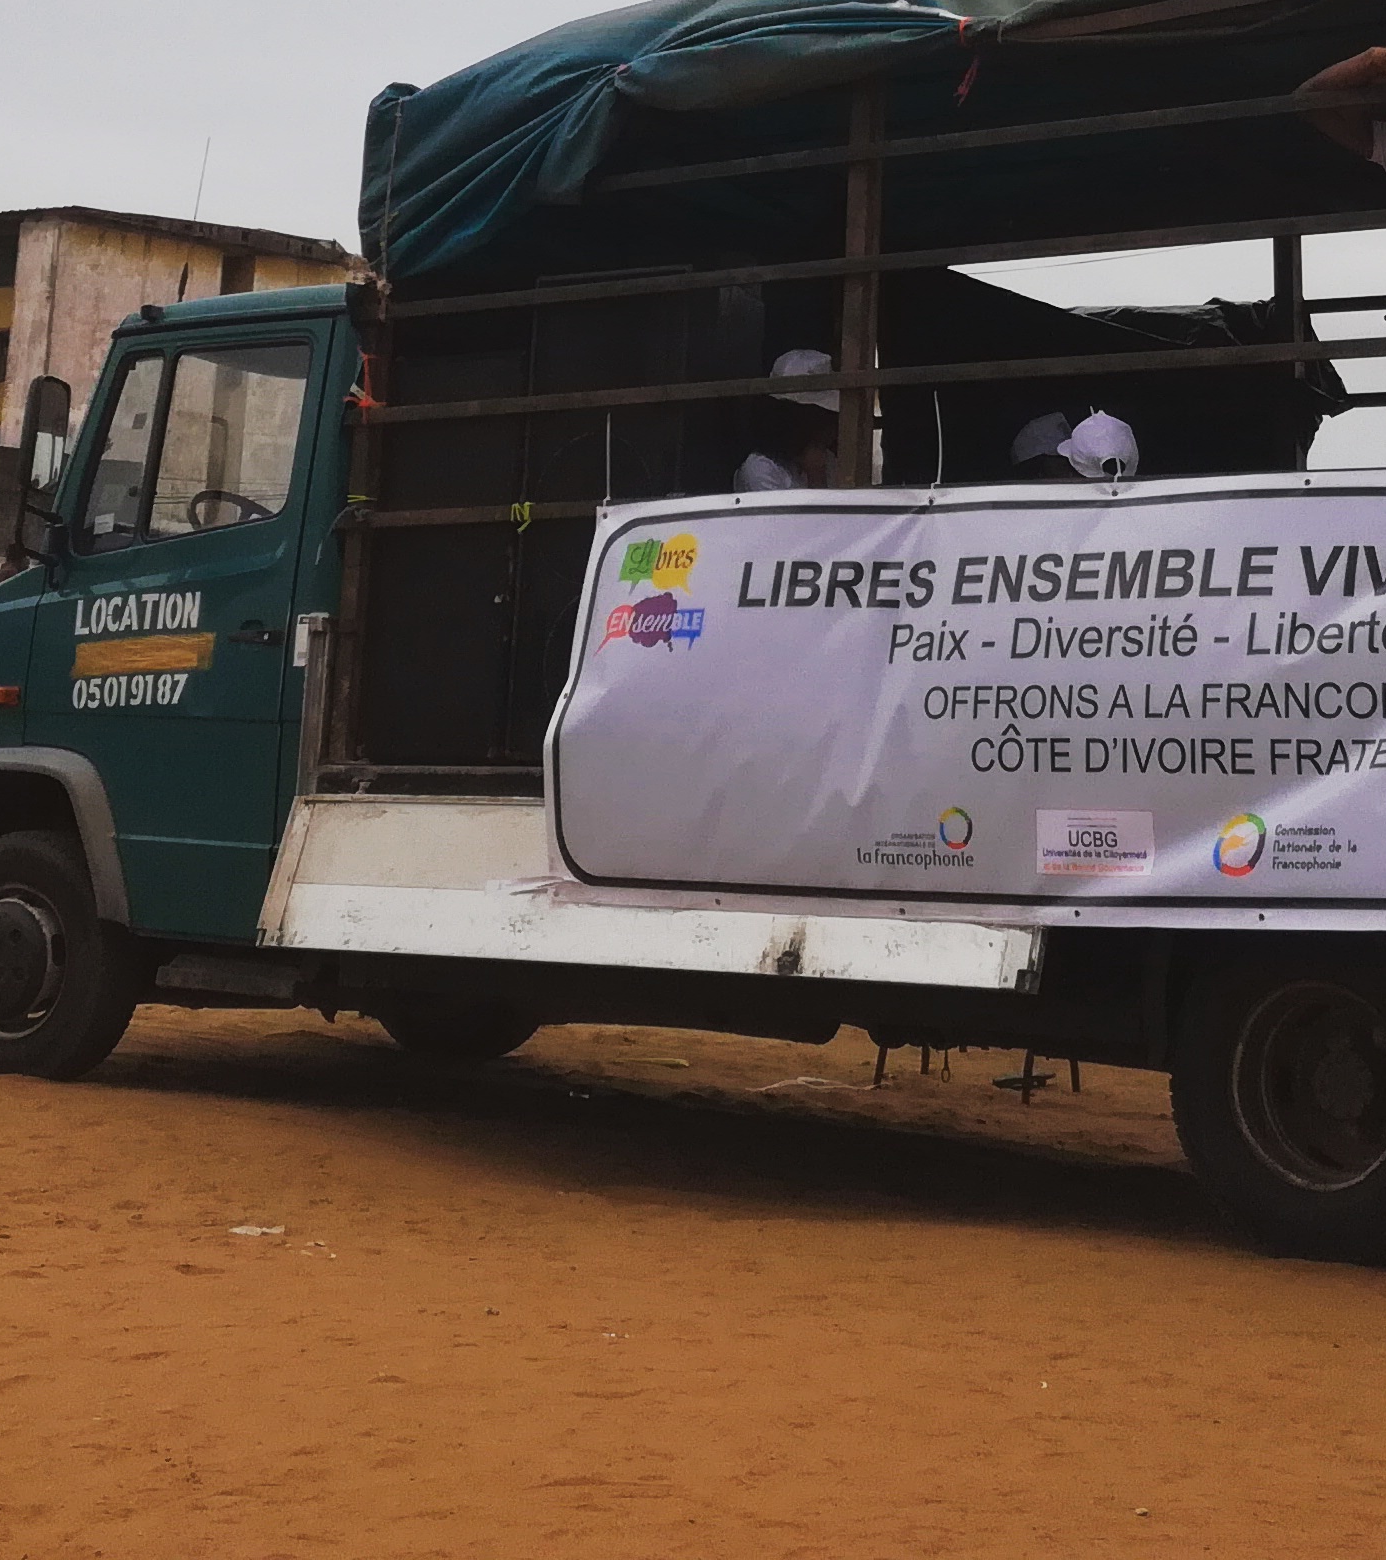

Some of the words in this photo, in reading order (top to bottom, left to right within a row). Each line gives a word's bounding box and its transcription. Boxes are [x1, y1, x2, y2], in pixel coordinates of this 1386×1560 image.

[738, 559, 936, 608] LIBRES
[951, 546, 1278, 605] ENSEMBLE
[74, 591, 201, 635] LOCATION
[888, 620, 969, 664] Paix
[1011, 613, 1198, 659] Diversité
[924, 685, 1099, 720] OFFRONS
[1108, 684, 1134, 719] A
[1144, 684, 1190, 719] LA
[971, 723, 1072, 773] CÔTE
[1085, 737, 1255, 775] D'IVOIRE
[1068, 830, 1118, 848] UCBG
[1273, 840, 1322, 853] Nationale
[1329, 841, 1342, 853] de
[1348, 840, 1357, 853] la
[1275, 824, 1335, 836] Commission
[1272, 857, 1342, 871] Francophonie
